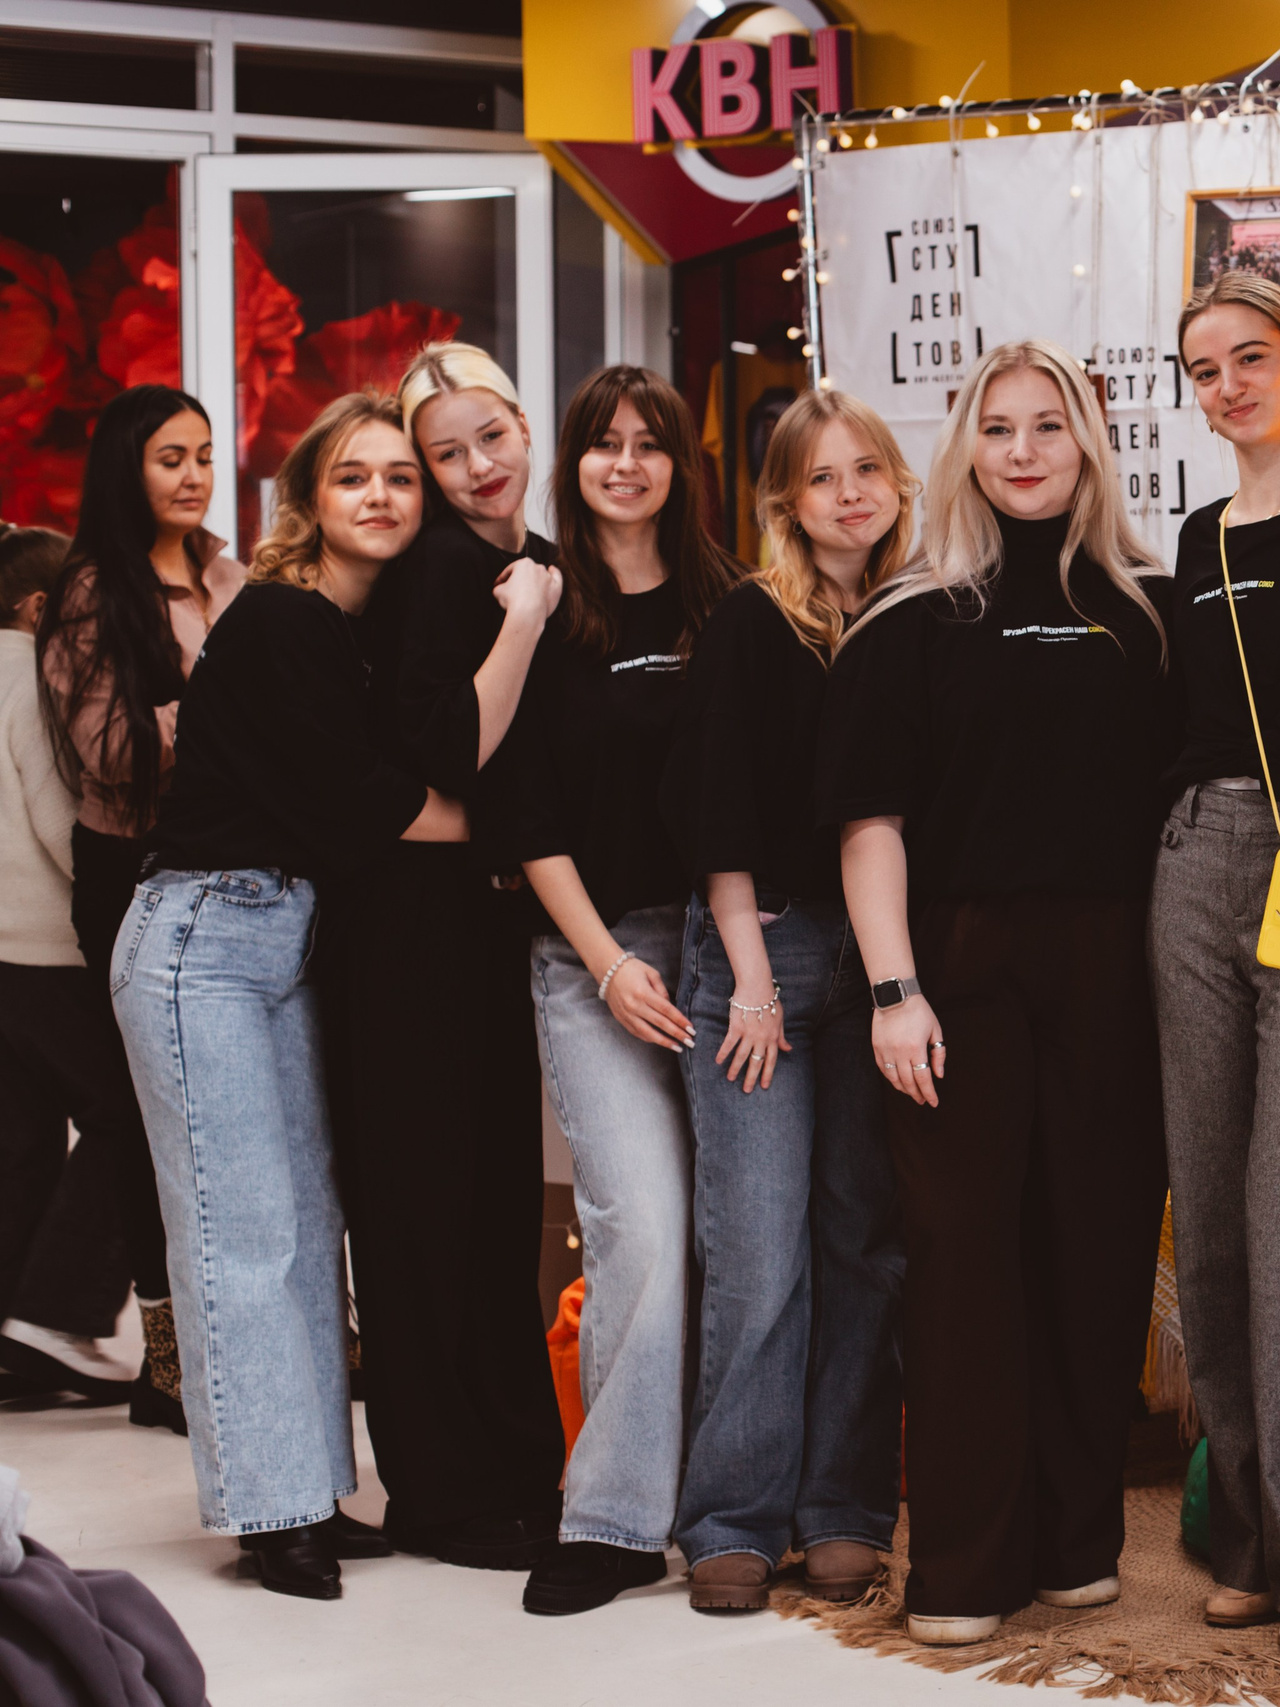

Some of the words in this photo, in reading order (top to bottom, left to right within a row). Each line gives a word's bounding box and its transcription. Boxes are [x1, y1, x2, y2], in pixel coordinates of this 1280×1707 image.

[631, 26, 842, 145] КВН
[911, 217, 955, 235] СОЮЗ
[911, 243, 958, 271] СТУ
[910, 292, 961, 322] ДЕН
[913, 340, 962, 367] ТОВ
[1106, 346, 1155, 364] СОЮЗ
[1106, 374, 1157, 401] СТУ
[1108, 423, 1159, 453] ДЕН
